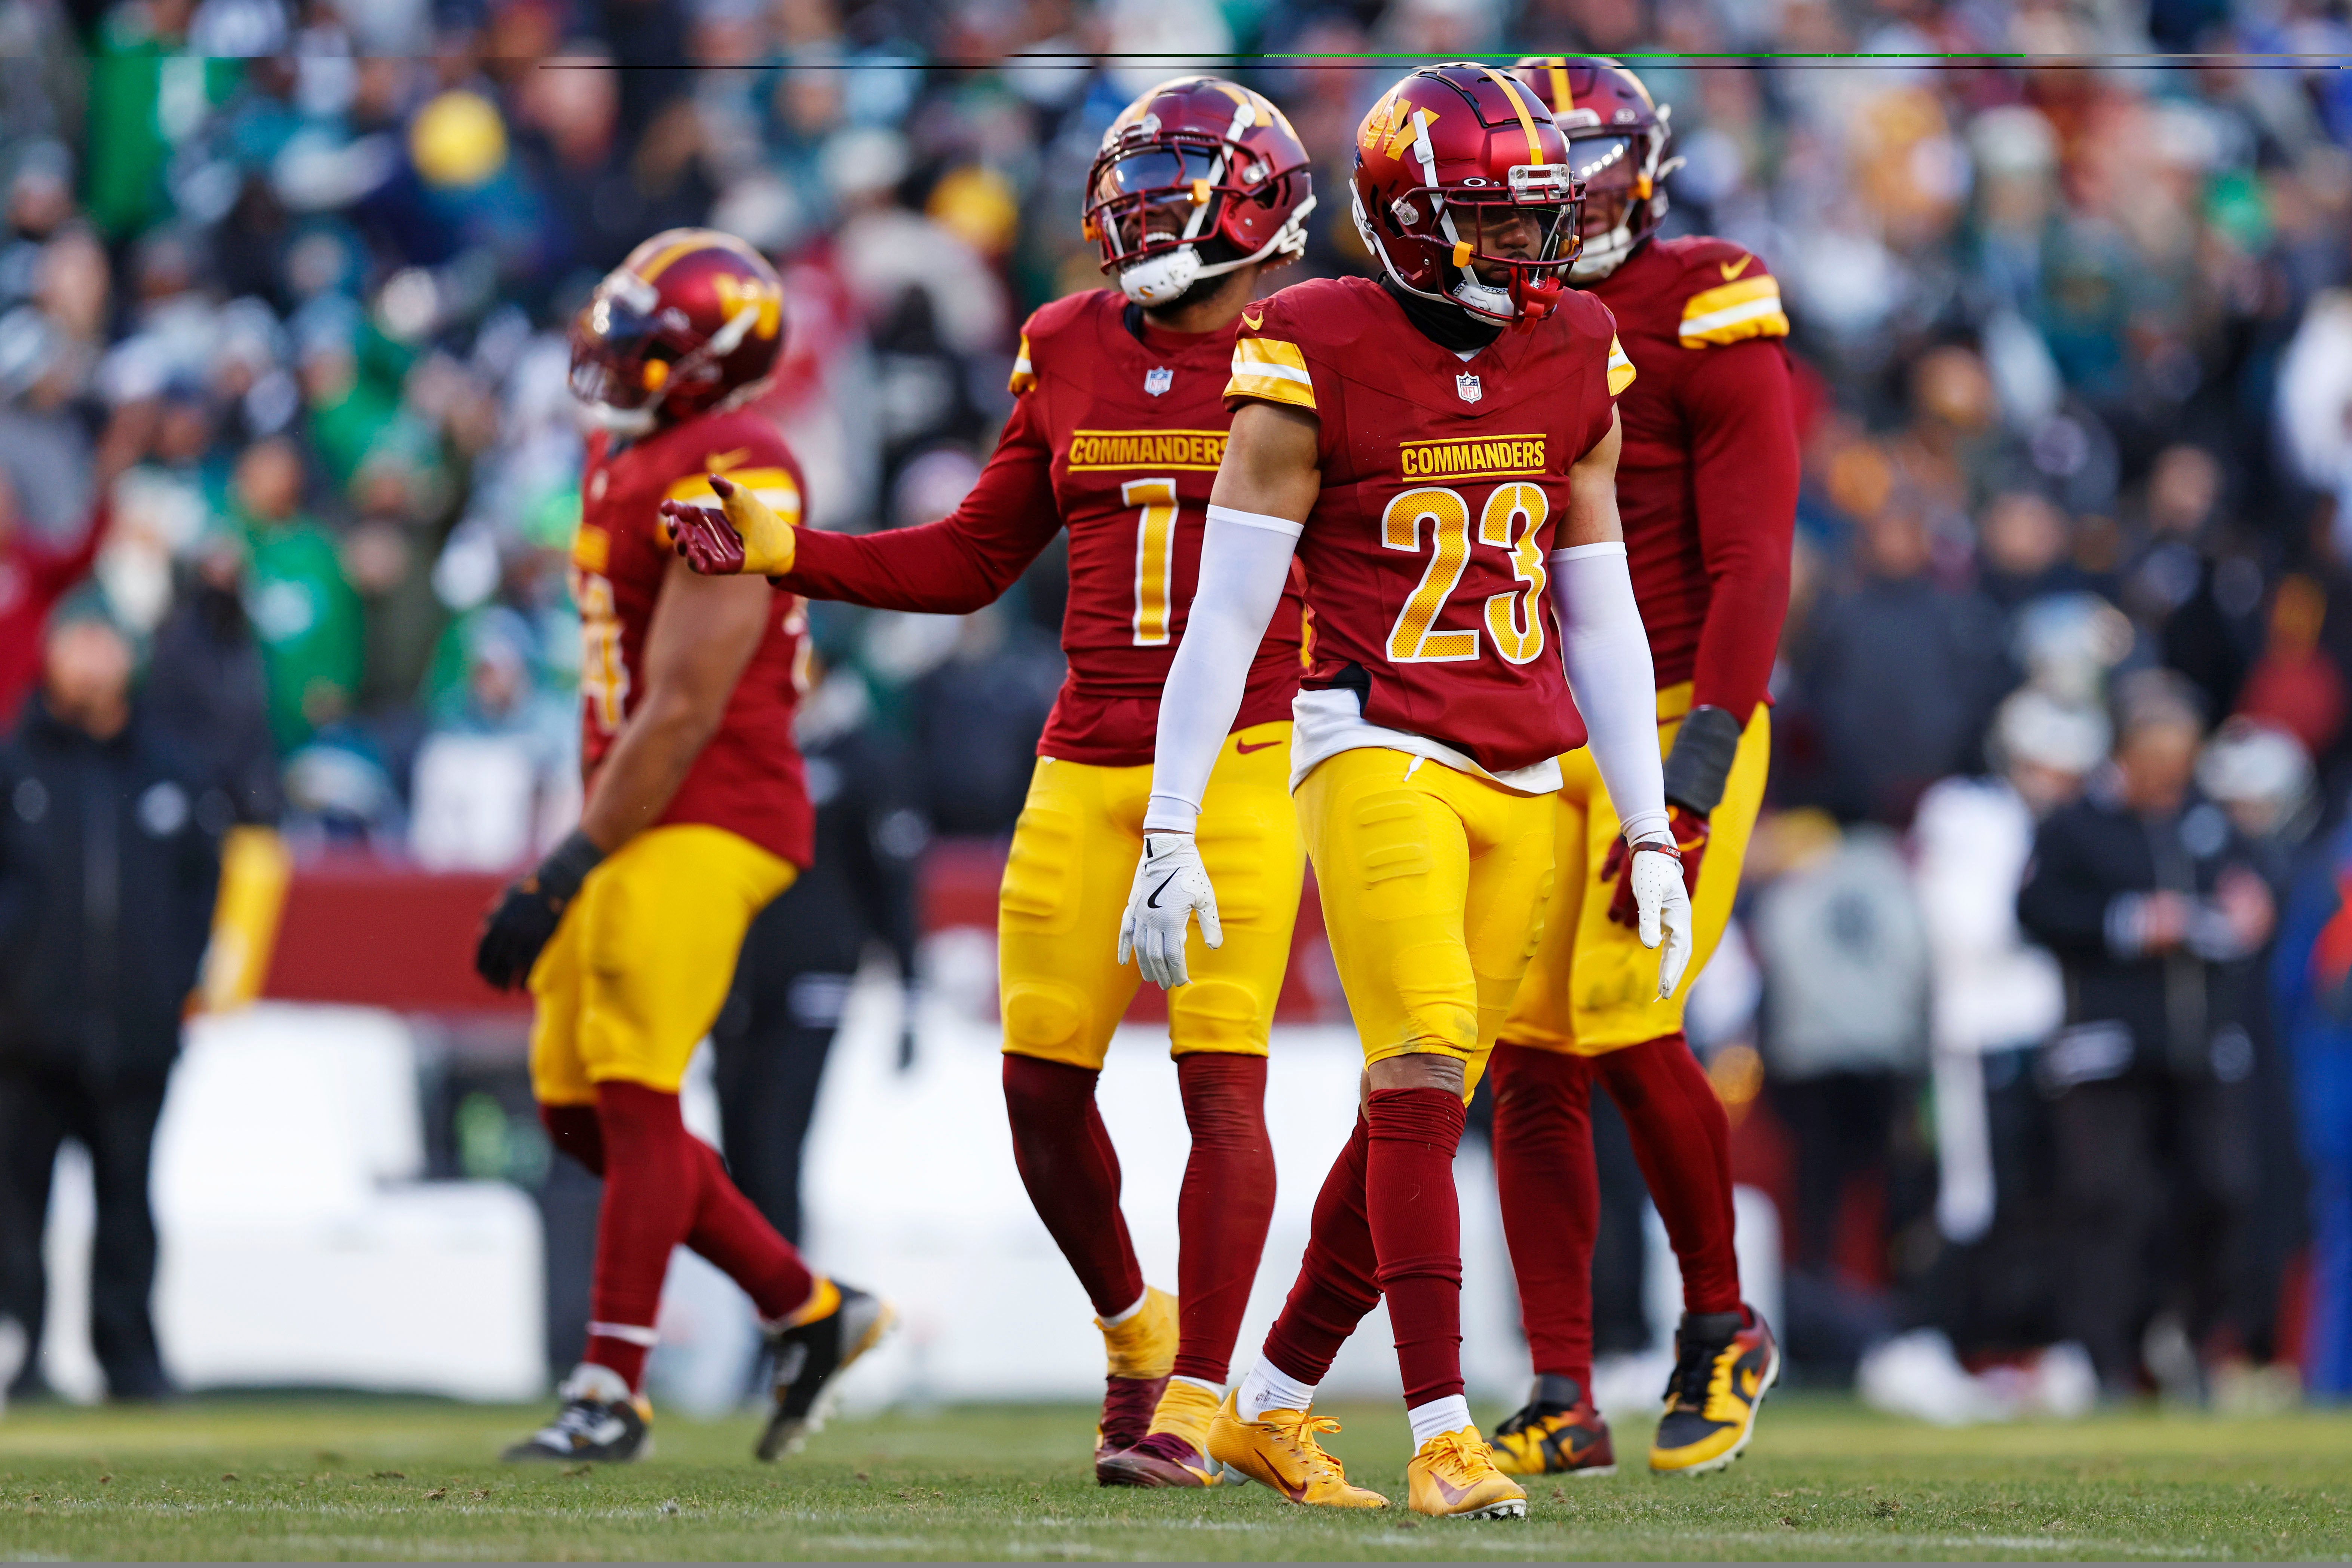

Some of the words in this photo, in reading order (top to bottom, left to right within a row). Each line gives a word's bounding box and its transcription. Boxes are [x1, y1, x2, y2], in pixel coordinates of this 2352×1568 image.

[1462, 386, 1478, 398] NFL
[1401, 441, 1545, 475] COMMANDERS
[1121, 477, 1179, 646] 1
[1382, 482, 1549, 665] 23
